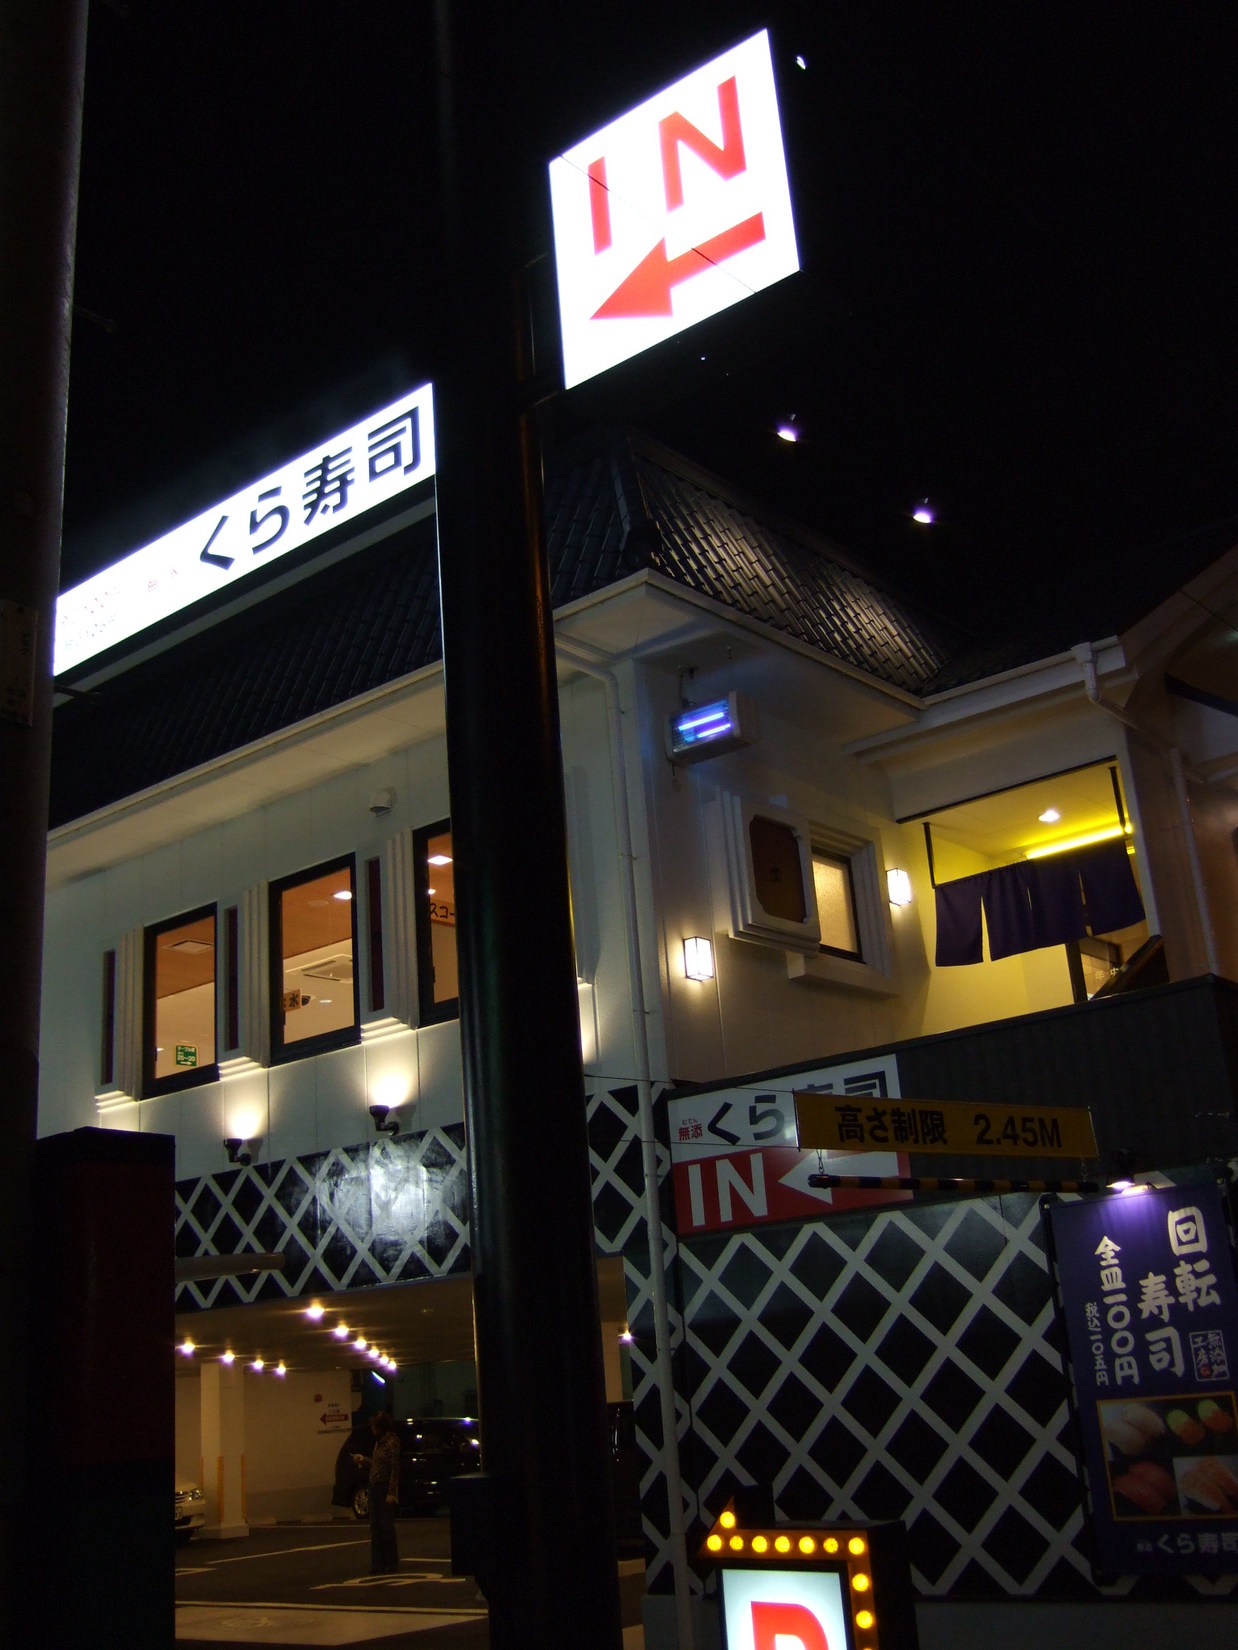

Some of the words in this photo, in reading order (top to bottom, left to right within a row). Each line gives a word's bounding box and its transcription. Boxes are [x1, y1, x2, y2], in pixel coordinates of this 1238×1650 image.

[588, 75, 747, 257] IN
[199, 406, 421, 572] くら寿司
[678, 1123, 703, 1142] 無添
[834, 1104, 947, 1147] 高さ制限
[973, 1113, 1063, 1149] 2.45M
[687, 1152, 769, 1228] IN
[1167, 1205, 1221, 1313] 回転
[1137, 1271, 1186, 1379] 寿司
